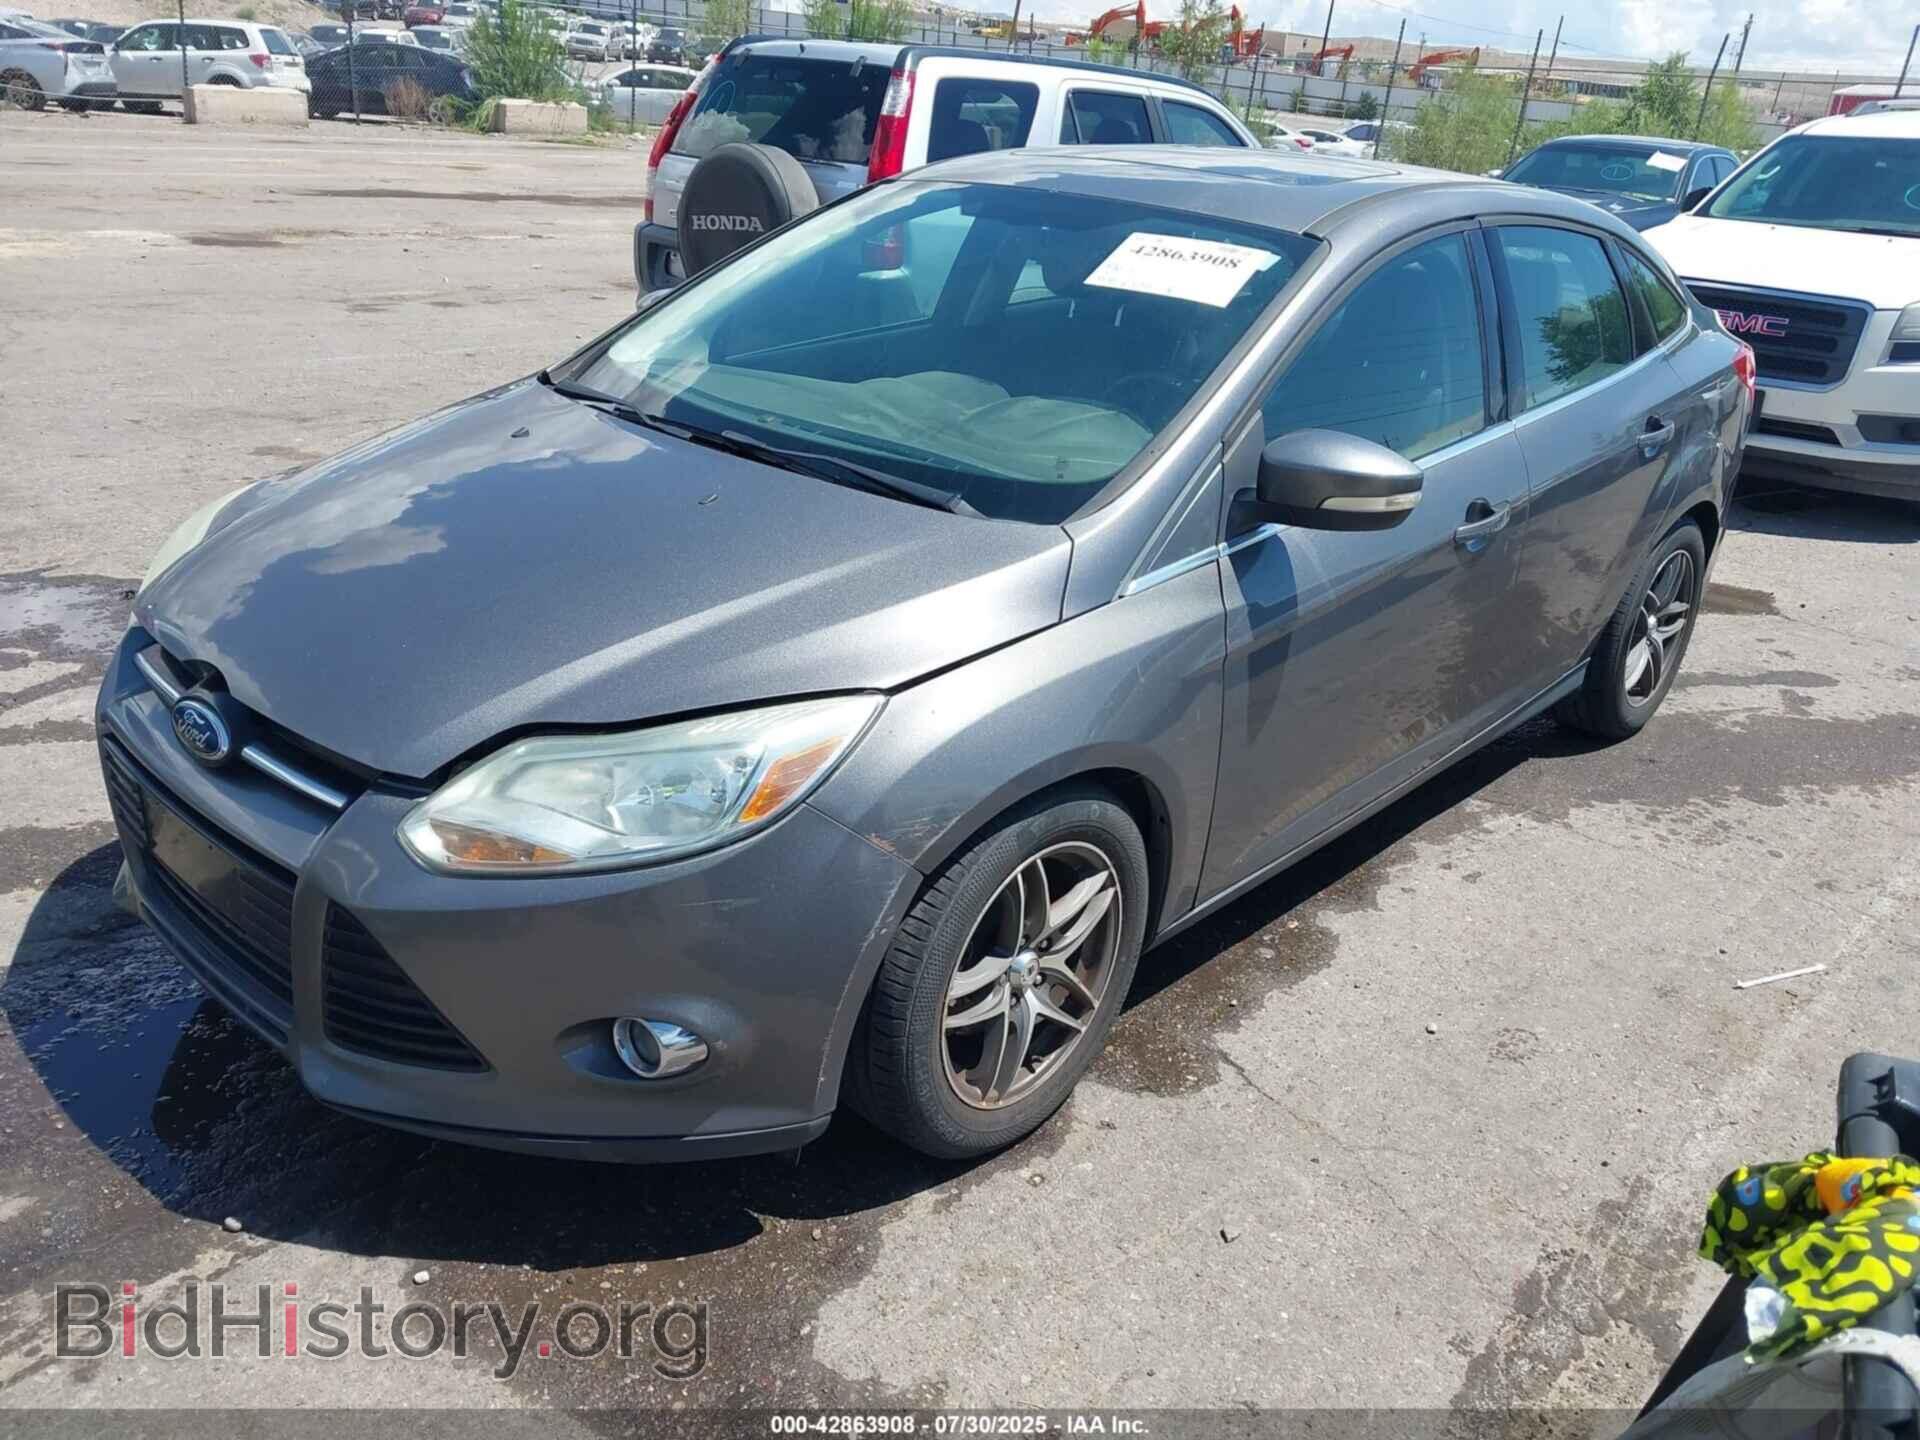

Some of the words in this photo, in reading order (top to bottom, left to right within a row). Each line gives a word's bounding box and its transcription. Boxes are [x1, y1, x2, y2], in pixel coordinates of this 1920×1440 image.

[692, 214, 764, 232] HONDA
[1130, 244, 1242, 269] 42863908
[178, 709, 210, 748] Ford
